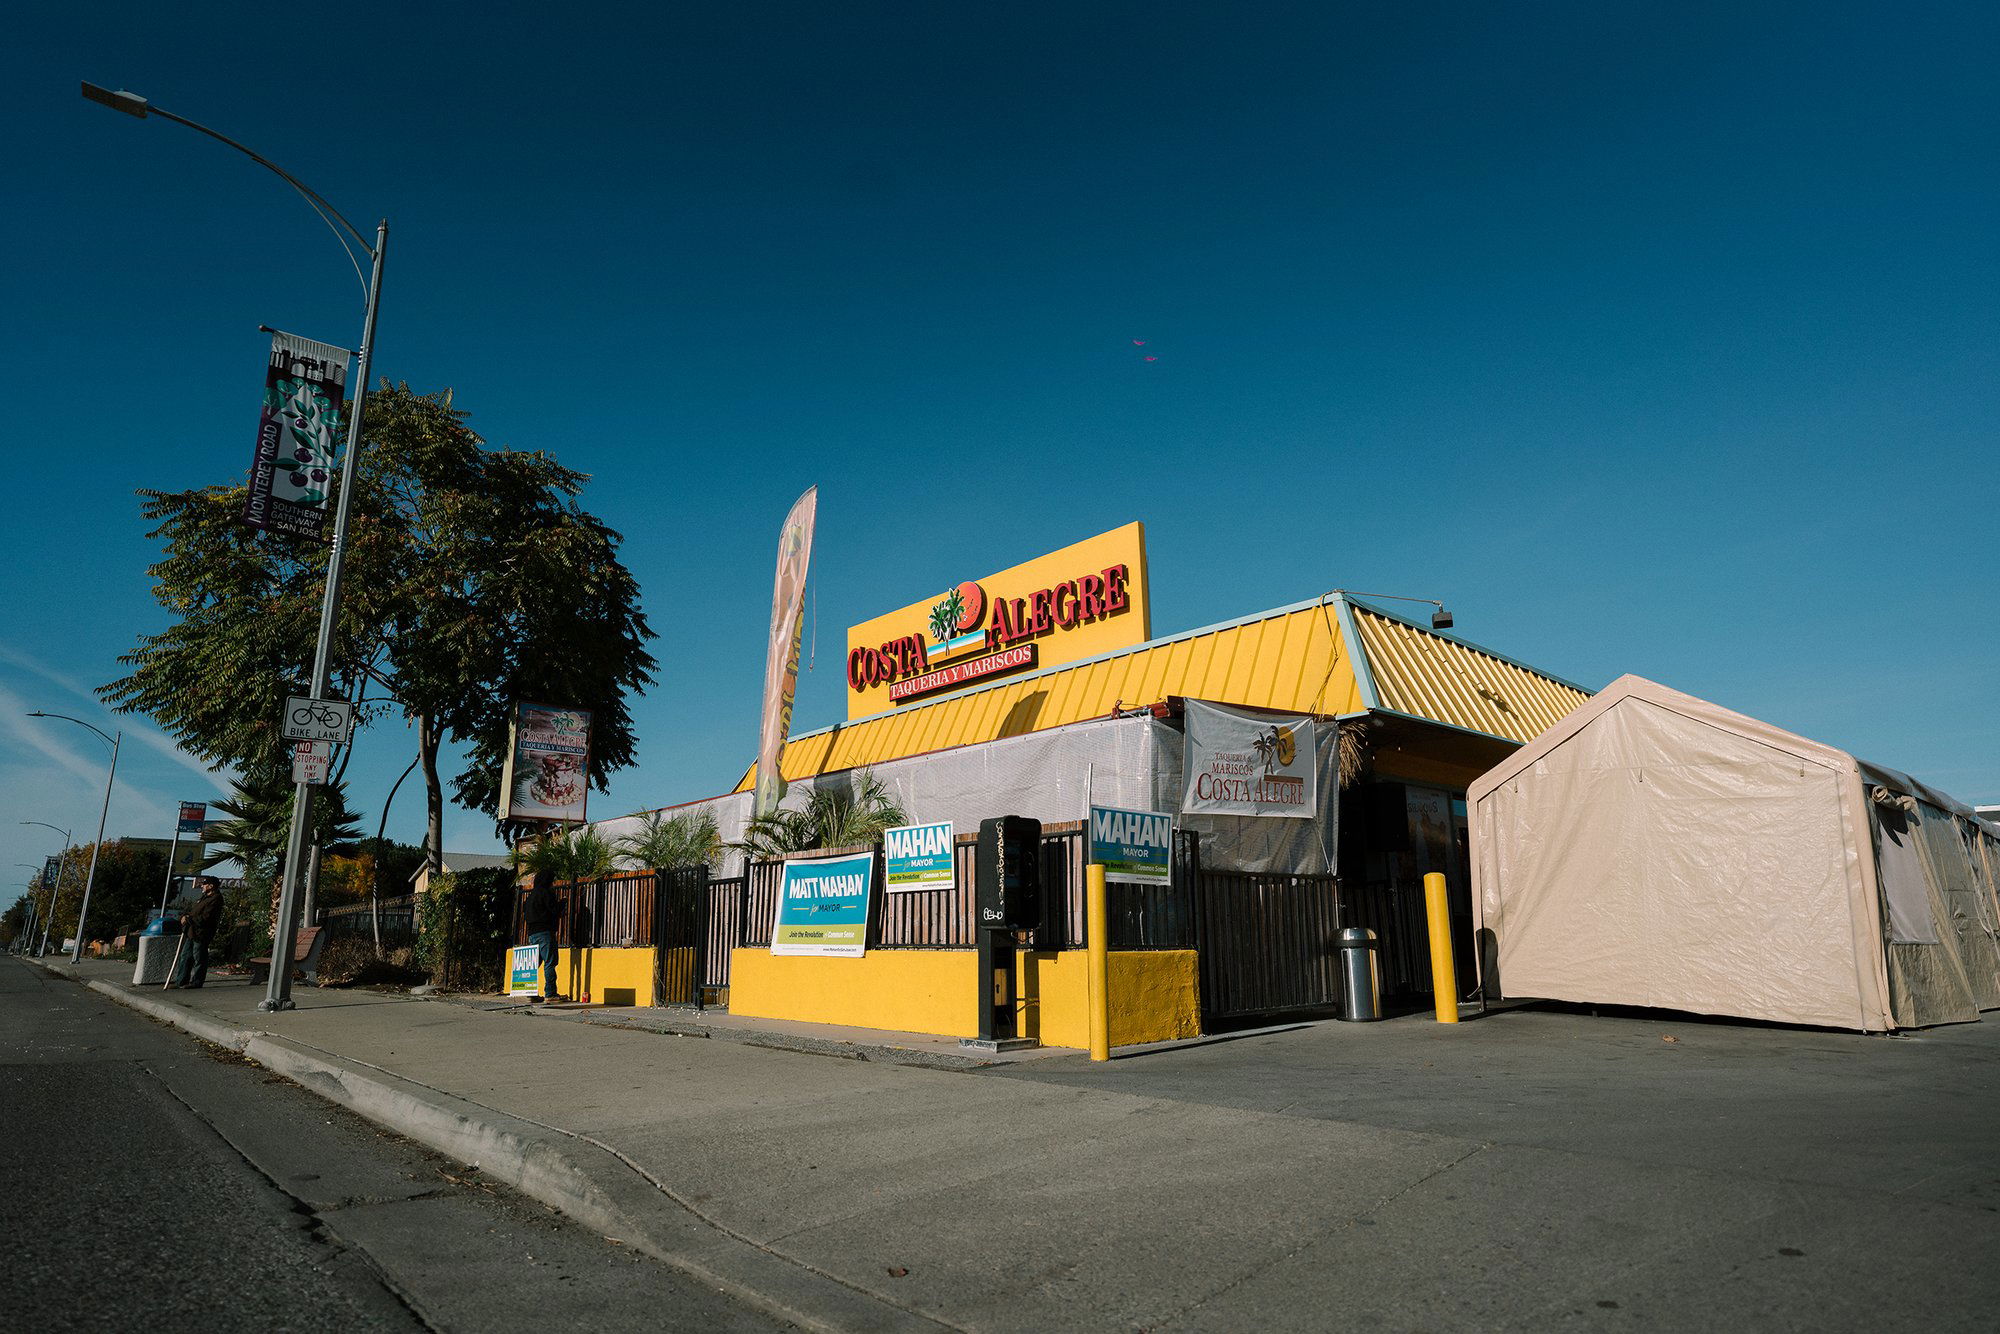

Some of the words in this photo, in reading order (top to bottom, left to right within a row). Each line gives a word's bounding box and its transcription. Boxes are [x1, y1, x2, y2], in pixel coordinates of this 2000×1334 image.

[248, 456, 271, 524] MONTEREY
[261, 424, 278, 456] ROAD
[270, 510, 316, 528] GATEWAY
[272, 501, 323, 520] SOUTHERN
[276, 521, 297, 532] SAN
[298, 527, 320, 538] JOSE
[847, 632, 926, 689] COSTA
[987, 563, 1127, 647] ALEGRE
[890, 671, 949, 699] TAQUERIA
[951, 667, 960, 681] Y
[961, 644, 1032, 679] MARISCOS
[290, 727, 311, 737] BIKE
[318, 730, 340, 740] LANE
[298, 742, 311, 752] NO
[297, 754, 327, 764] STOPPING
[1215, 752, 1245, 762] TAQUERIA
[1211, 762, 1254, 776] MARISCOS
[1197, 773, 1251, 802] COSTA
[1250, 777, 1305, 804] ALEGRE
[1092, 809, 1169, 848] MAHAN
[887, 825, 950, 859] MAHAN
[1122, 847, 1149, 858] MAYOR
[911, 858, 933, 867] MAYOR
[789, 877, 818, 899] MATT
[819, 873, 864, 898] MAHAN
[819, 903, 840, 912] MAYOR
[513, 948, 538, 971] MAHAN
